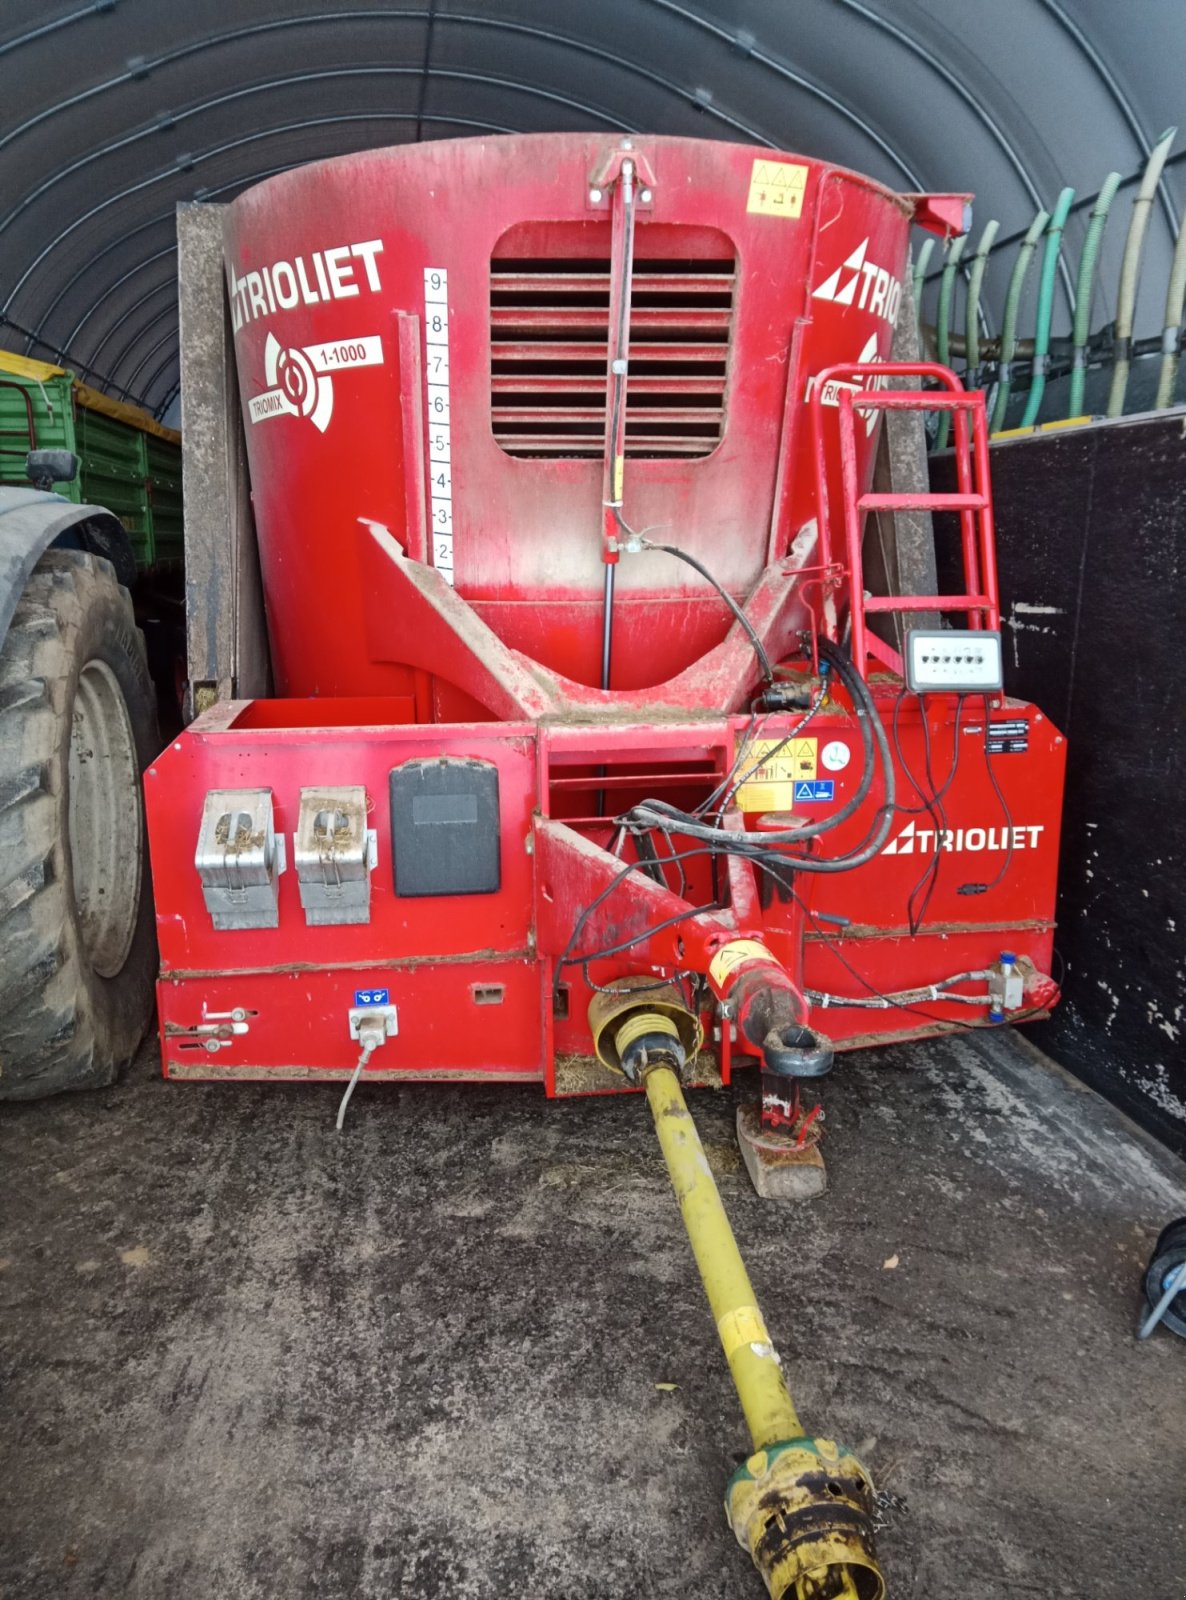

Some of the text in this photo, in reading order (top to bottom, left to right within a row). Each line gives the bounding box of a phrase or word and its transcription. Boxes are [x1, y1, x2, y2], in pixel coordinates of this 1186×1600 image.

[237, 239, 384, 323] TRIOLIET
[430, 273, 441, 290] 9
[858, 260, 902, 330] TRIO
[432, 315, 442, 333] 8
[320, 344, 367, 365] 1-1000
[433, 356, 443, 373] 7
[252, 394, 283, 417] TRIOMIX
[434, 396, 444, 413] 6
[435, 435, 445, 451] 5
[436, 473, 446, 489] 4
[438, 509, 447, 524] 3
[439, 544, 448, 559] 2
[916, 825, 1044, 853] TRIOLIET
